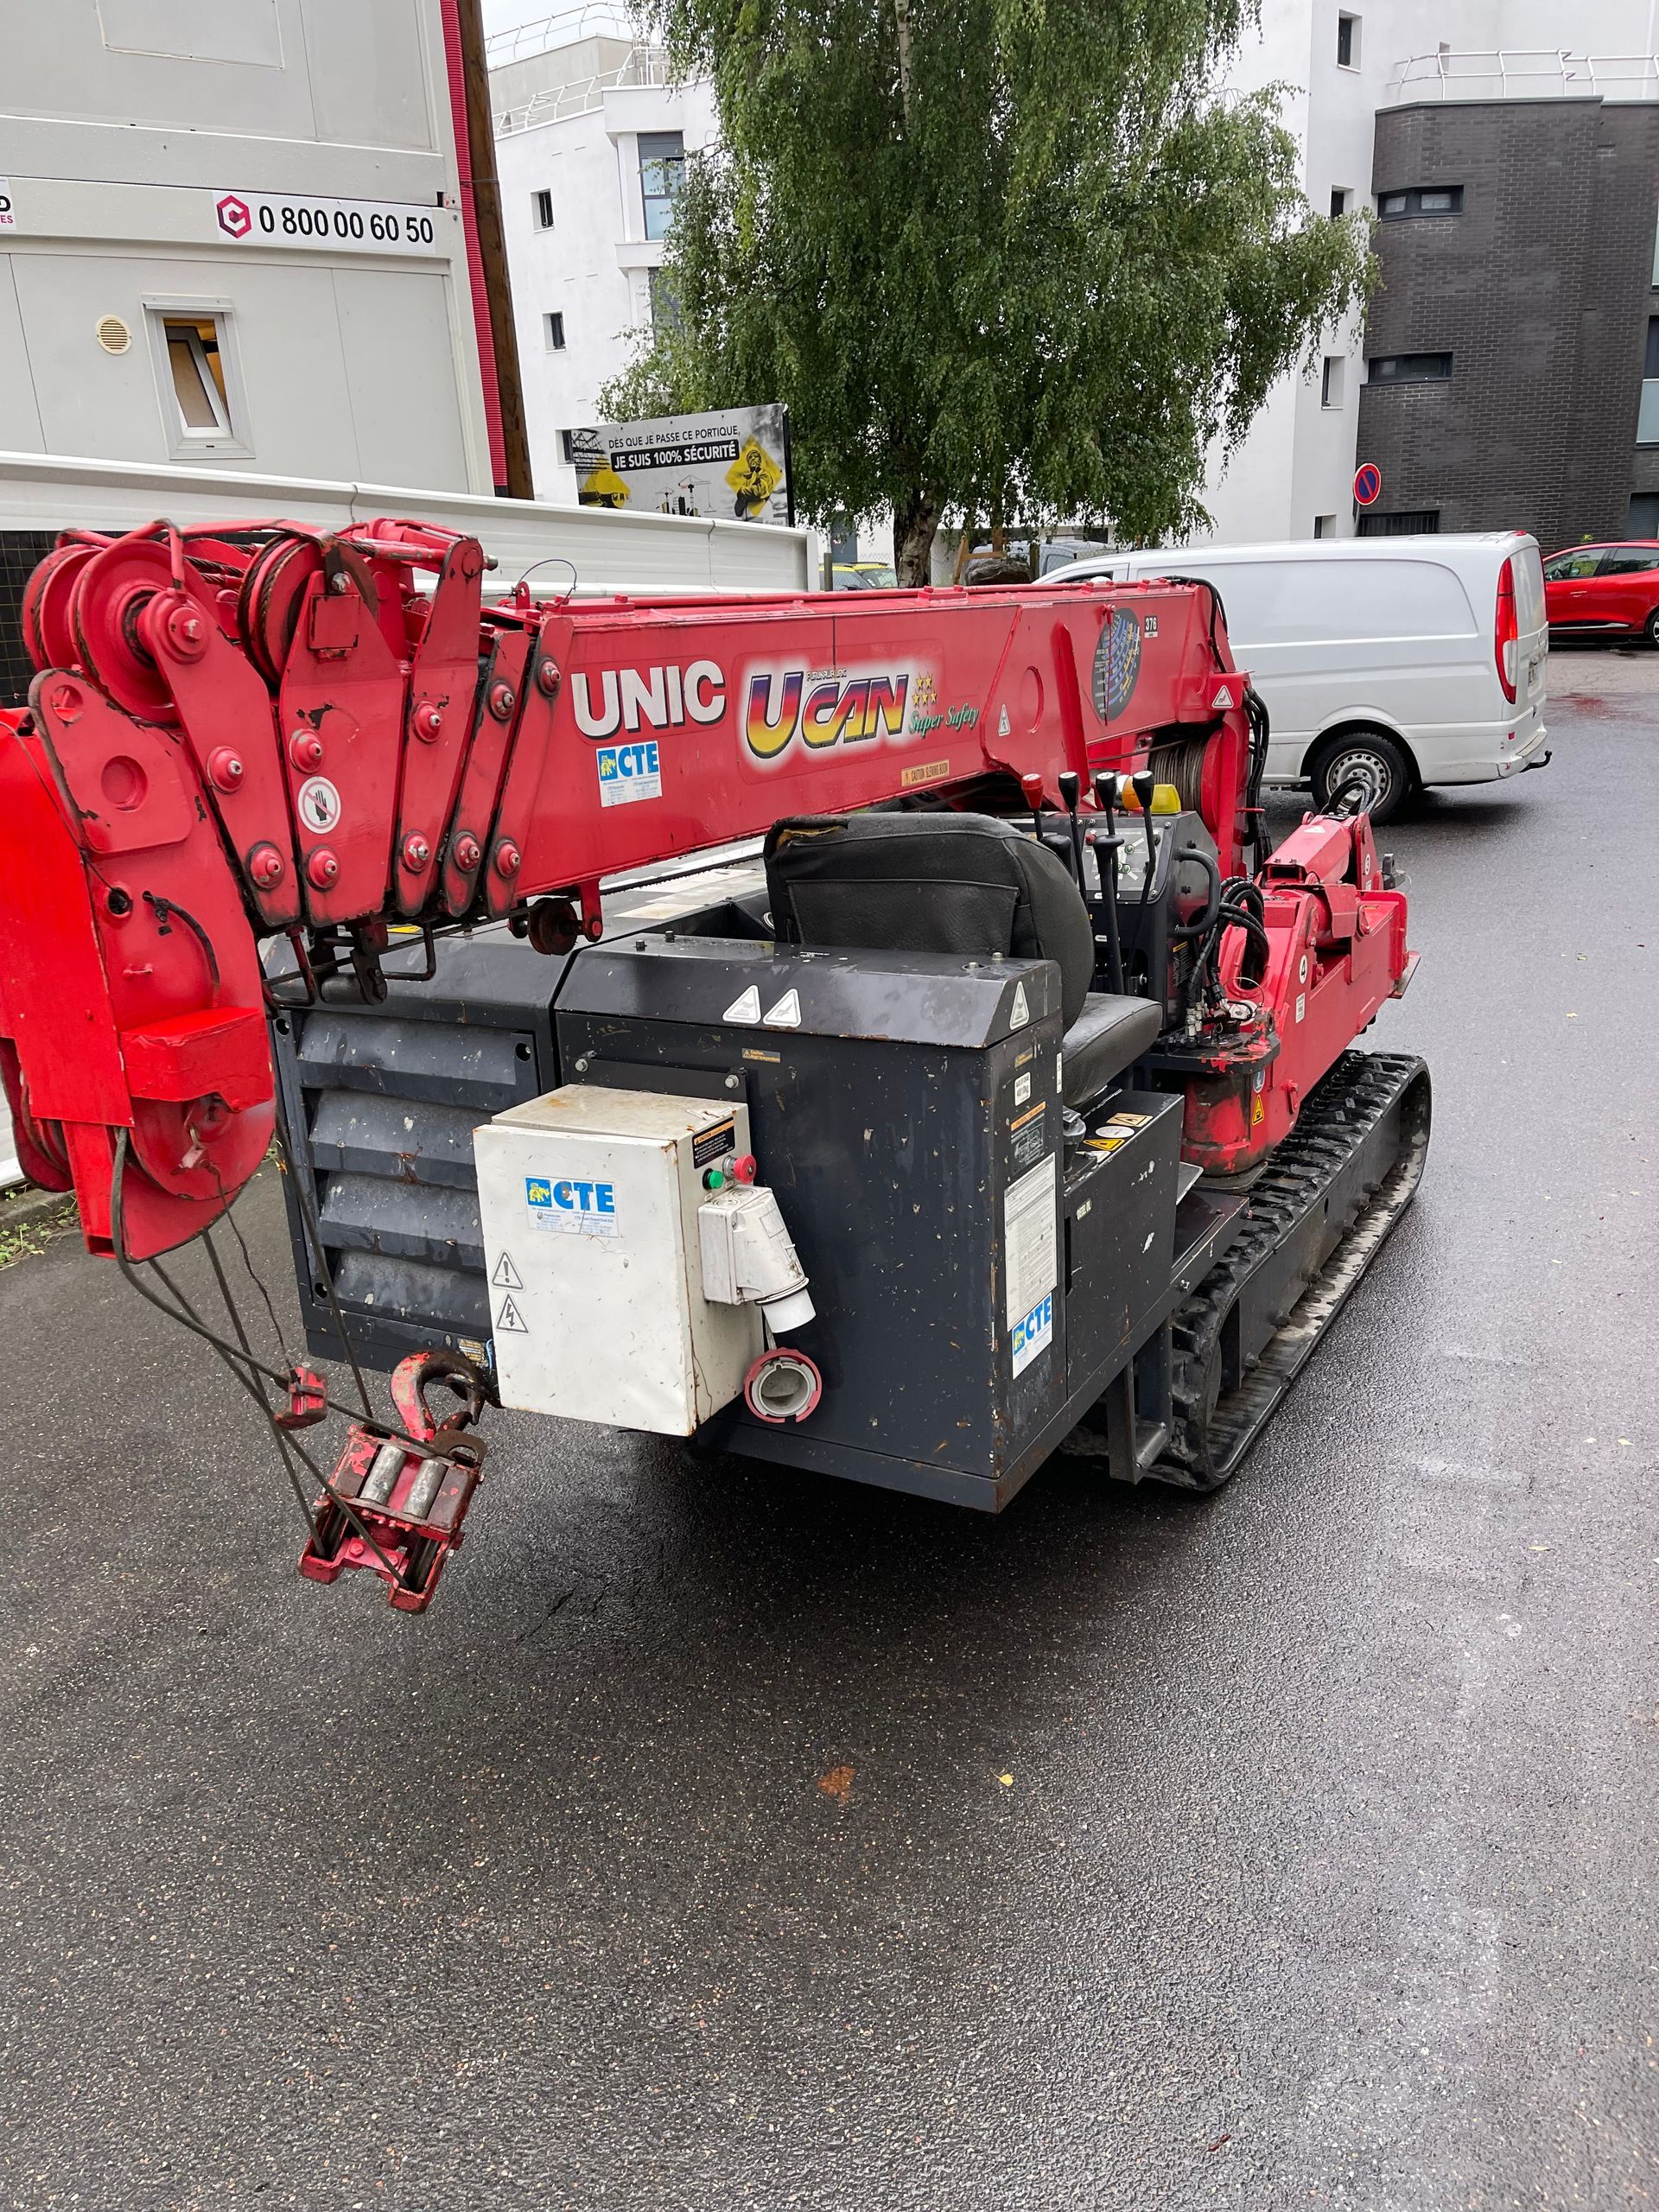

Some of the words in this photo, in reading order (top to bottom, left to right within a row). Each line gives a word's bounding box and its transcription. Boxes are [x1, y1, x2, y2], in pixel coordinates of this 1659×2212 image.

[259, 206, 275, 233] 0
[281, 207, 329, 237] 800
[334, 211, 364, 239] 00
[370, 213, 399, 242] 60
[406, 216, 433, 244] 50
[608, 436, 624, 449] DÈS
[626, 437, 643, 447] QUE
[645, 435, 654, 445] JE
[656, 432, 680, 444] PASSE
[682, 430, 693, 441] CE
[695, 425, 741, 440] PORTIQUE,
[614, 454, 626, 469] JE
[628, 453, 652, 467] SUIS
[653, 449, 683, 465] 100%
[683, 441, 736, 462] SÉCURITÉ
[1145, 617, 1157, 631] 376
[570, 659, 727, 741] UNIC
[908, 710, 944, 739] Super
[945, 702, 981, 731] Safety
[618, 743, 659, 778] CTE
[553, 1180, 615, 1213] CTE
[1025, 1295, 1052, 1341] CTE
